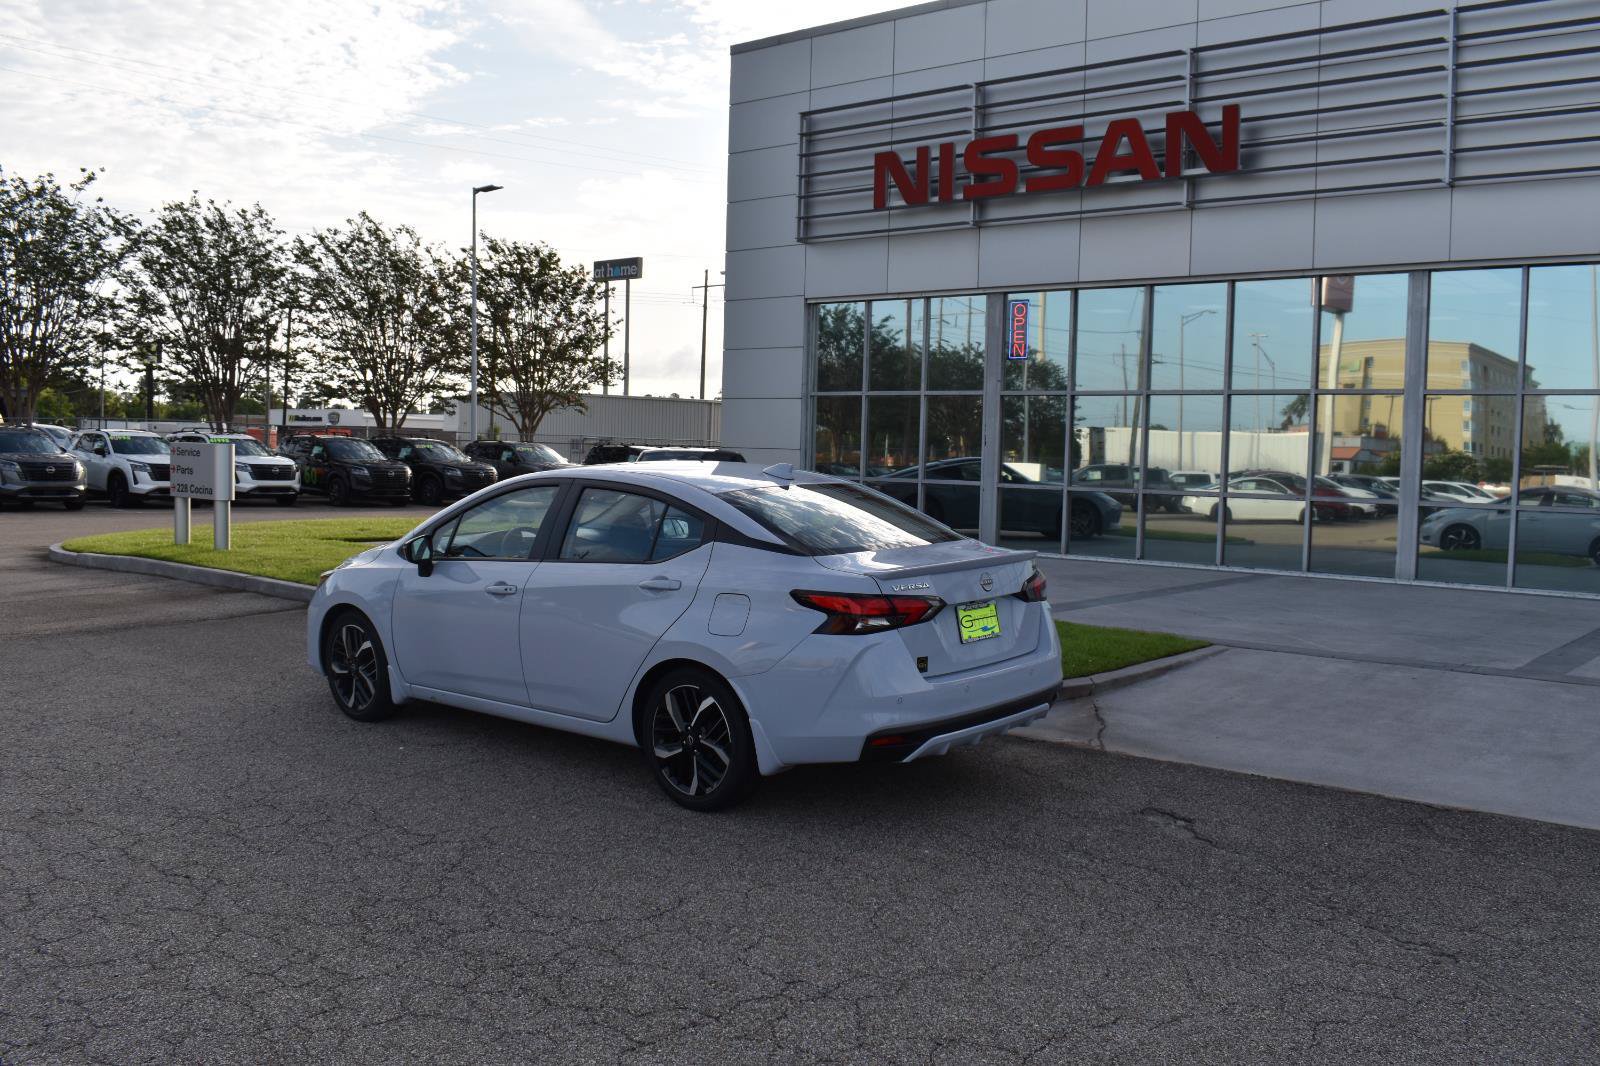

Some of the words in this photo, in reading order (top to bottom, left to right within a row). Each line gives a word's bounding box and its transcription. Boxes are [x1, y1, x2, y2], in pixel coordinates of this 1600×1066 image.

[873, 103, 1241, 209] NISSAN
[594, 265, 605, 278] at
[1013, 303, 1026, 357] OPEN
[176, 447, 201, 457] Service
[176, 464, 194, 475] Parts
[176, 483, 189, 493] 228
[189, 484, 213, 495] Cocina
[891, 582, 930, 592] VERSA
